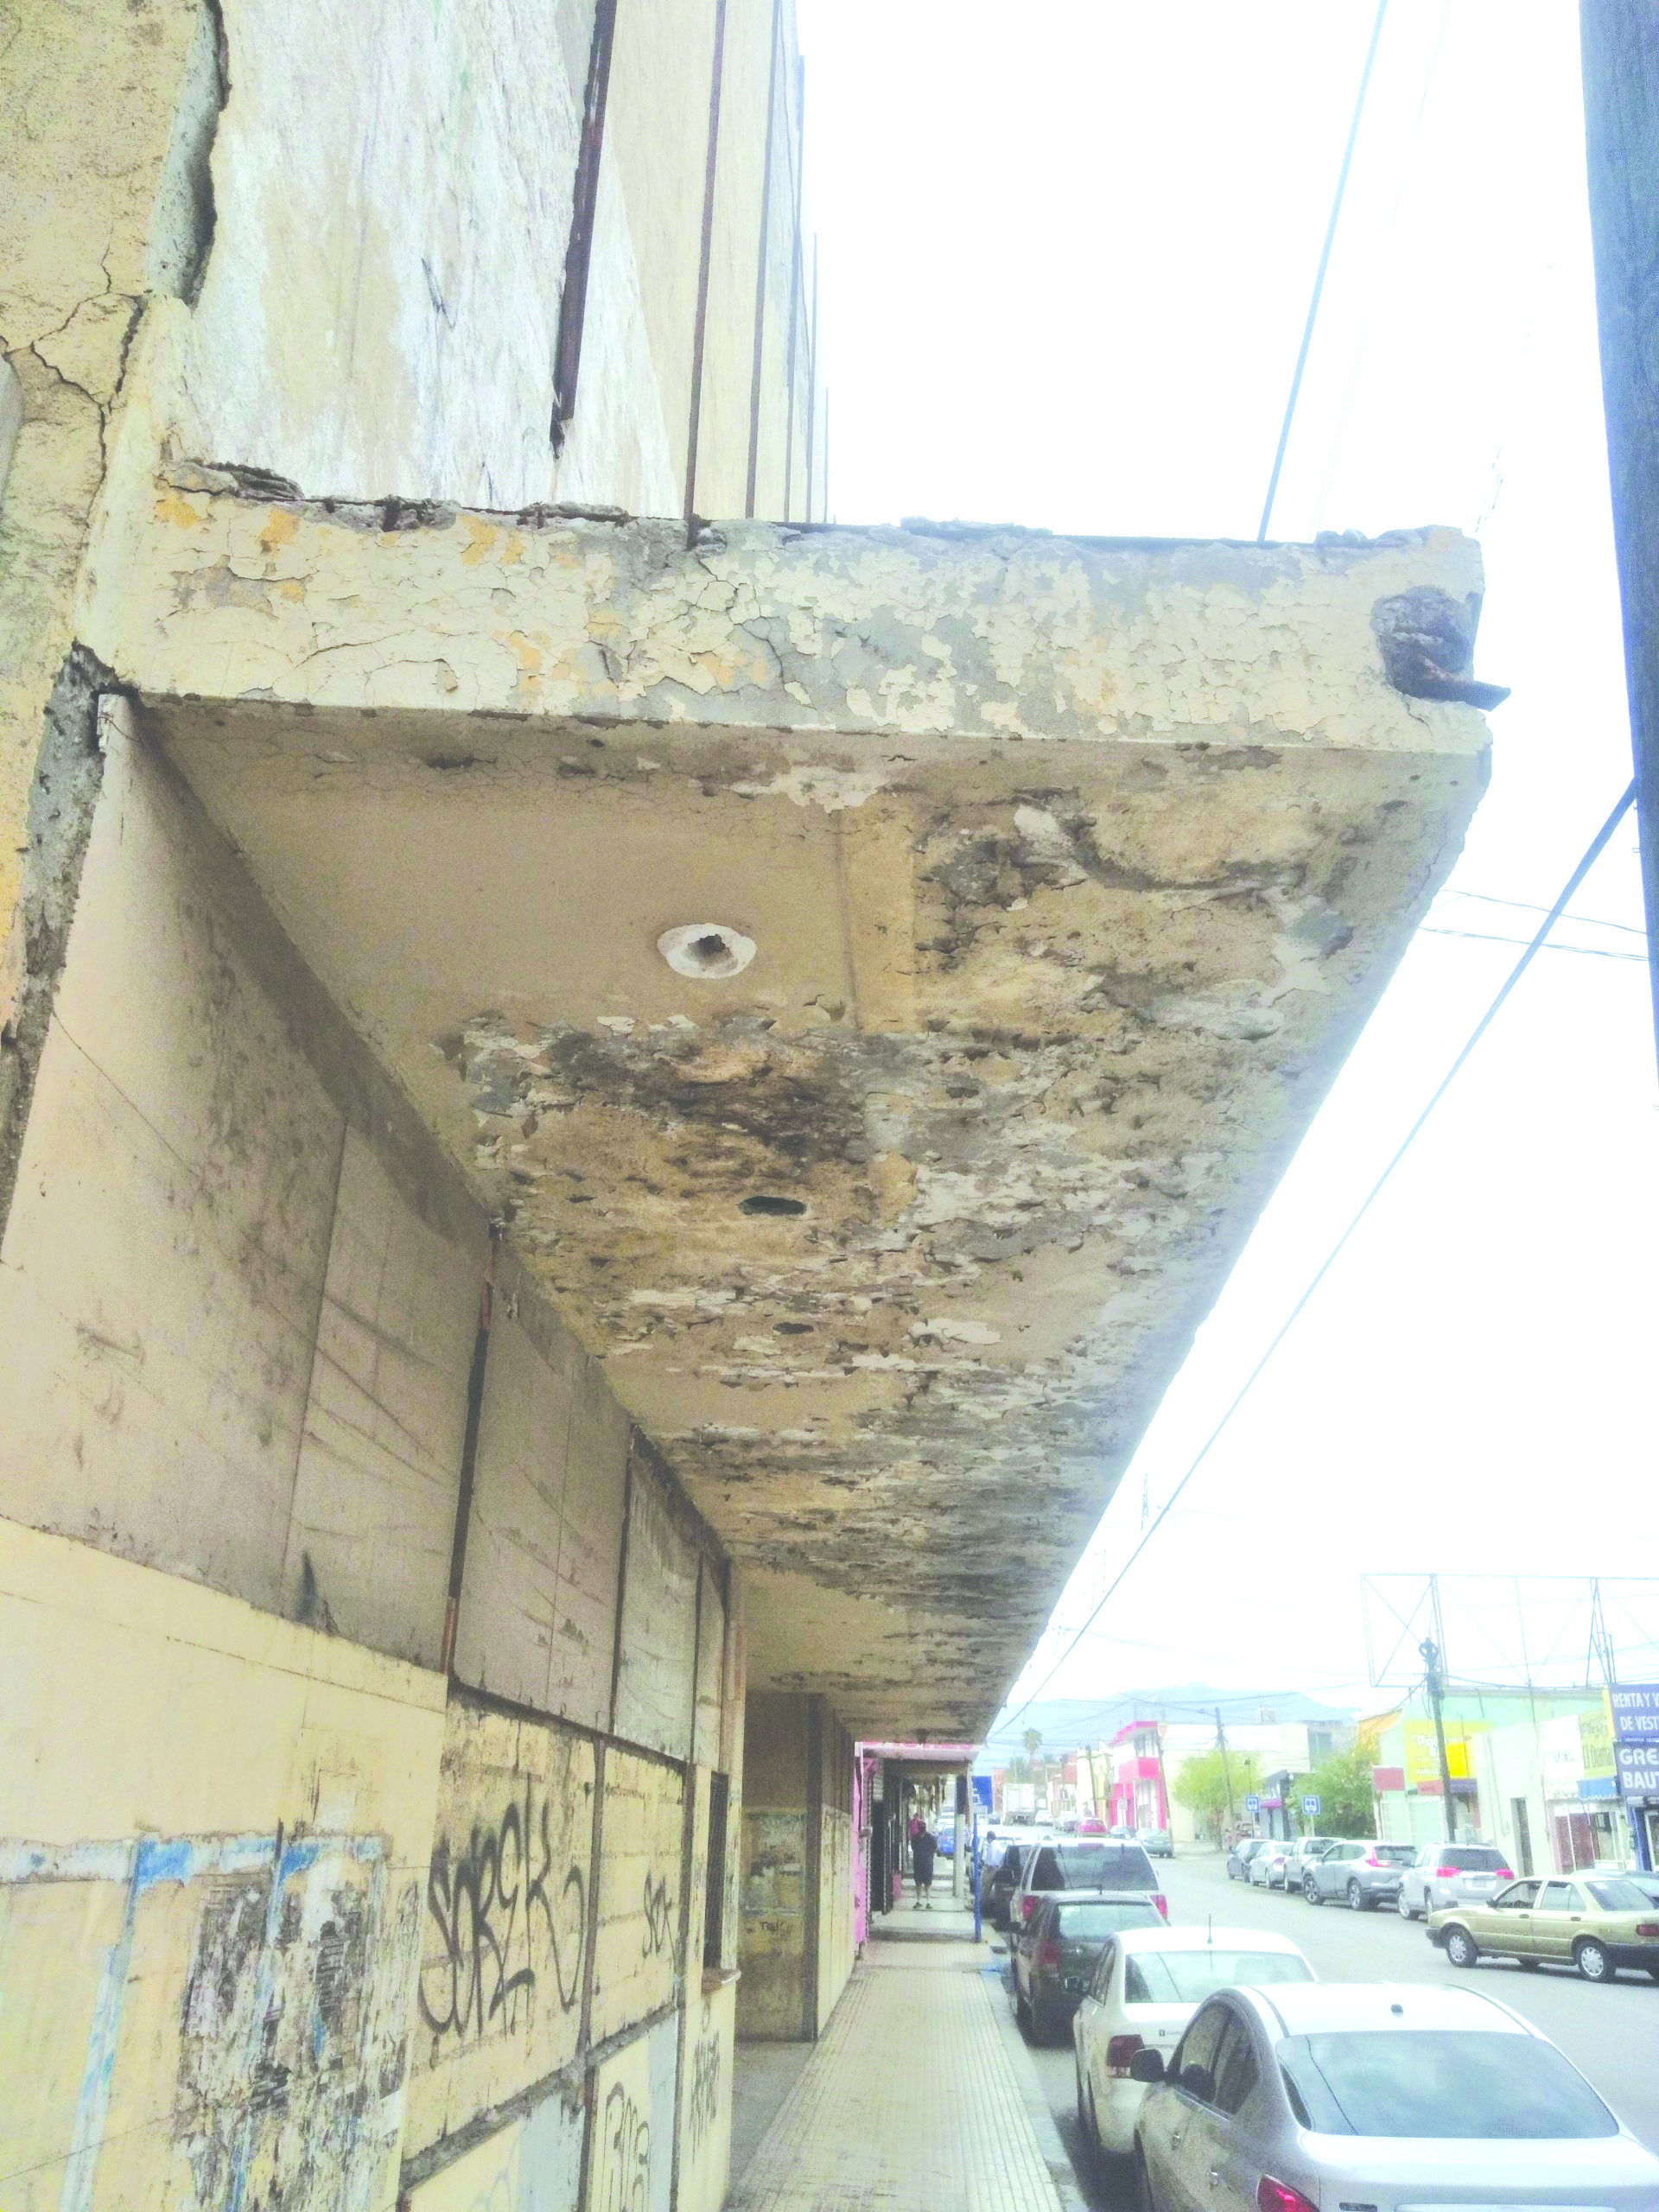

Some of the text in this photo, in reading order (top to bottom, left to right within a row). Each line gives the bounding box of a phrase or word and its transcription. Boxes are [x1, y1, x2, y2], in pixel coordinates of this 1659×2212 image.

[1612, 1693, 1643, 1707] RENTA
[1643, 1693, 1650, 1707] Y
[1620, 1716, 1633, 1730] DE
[1635, 1716, 1659, 1730] VEST
